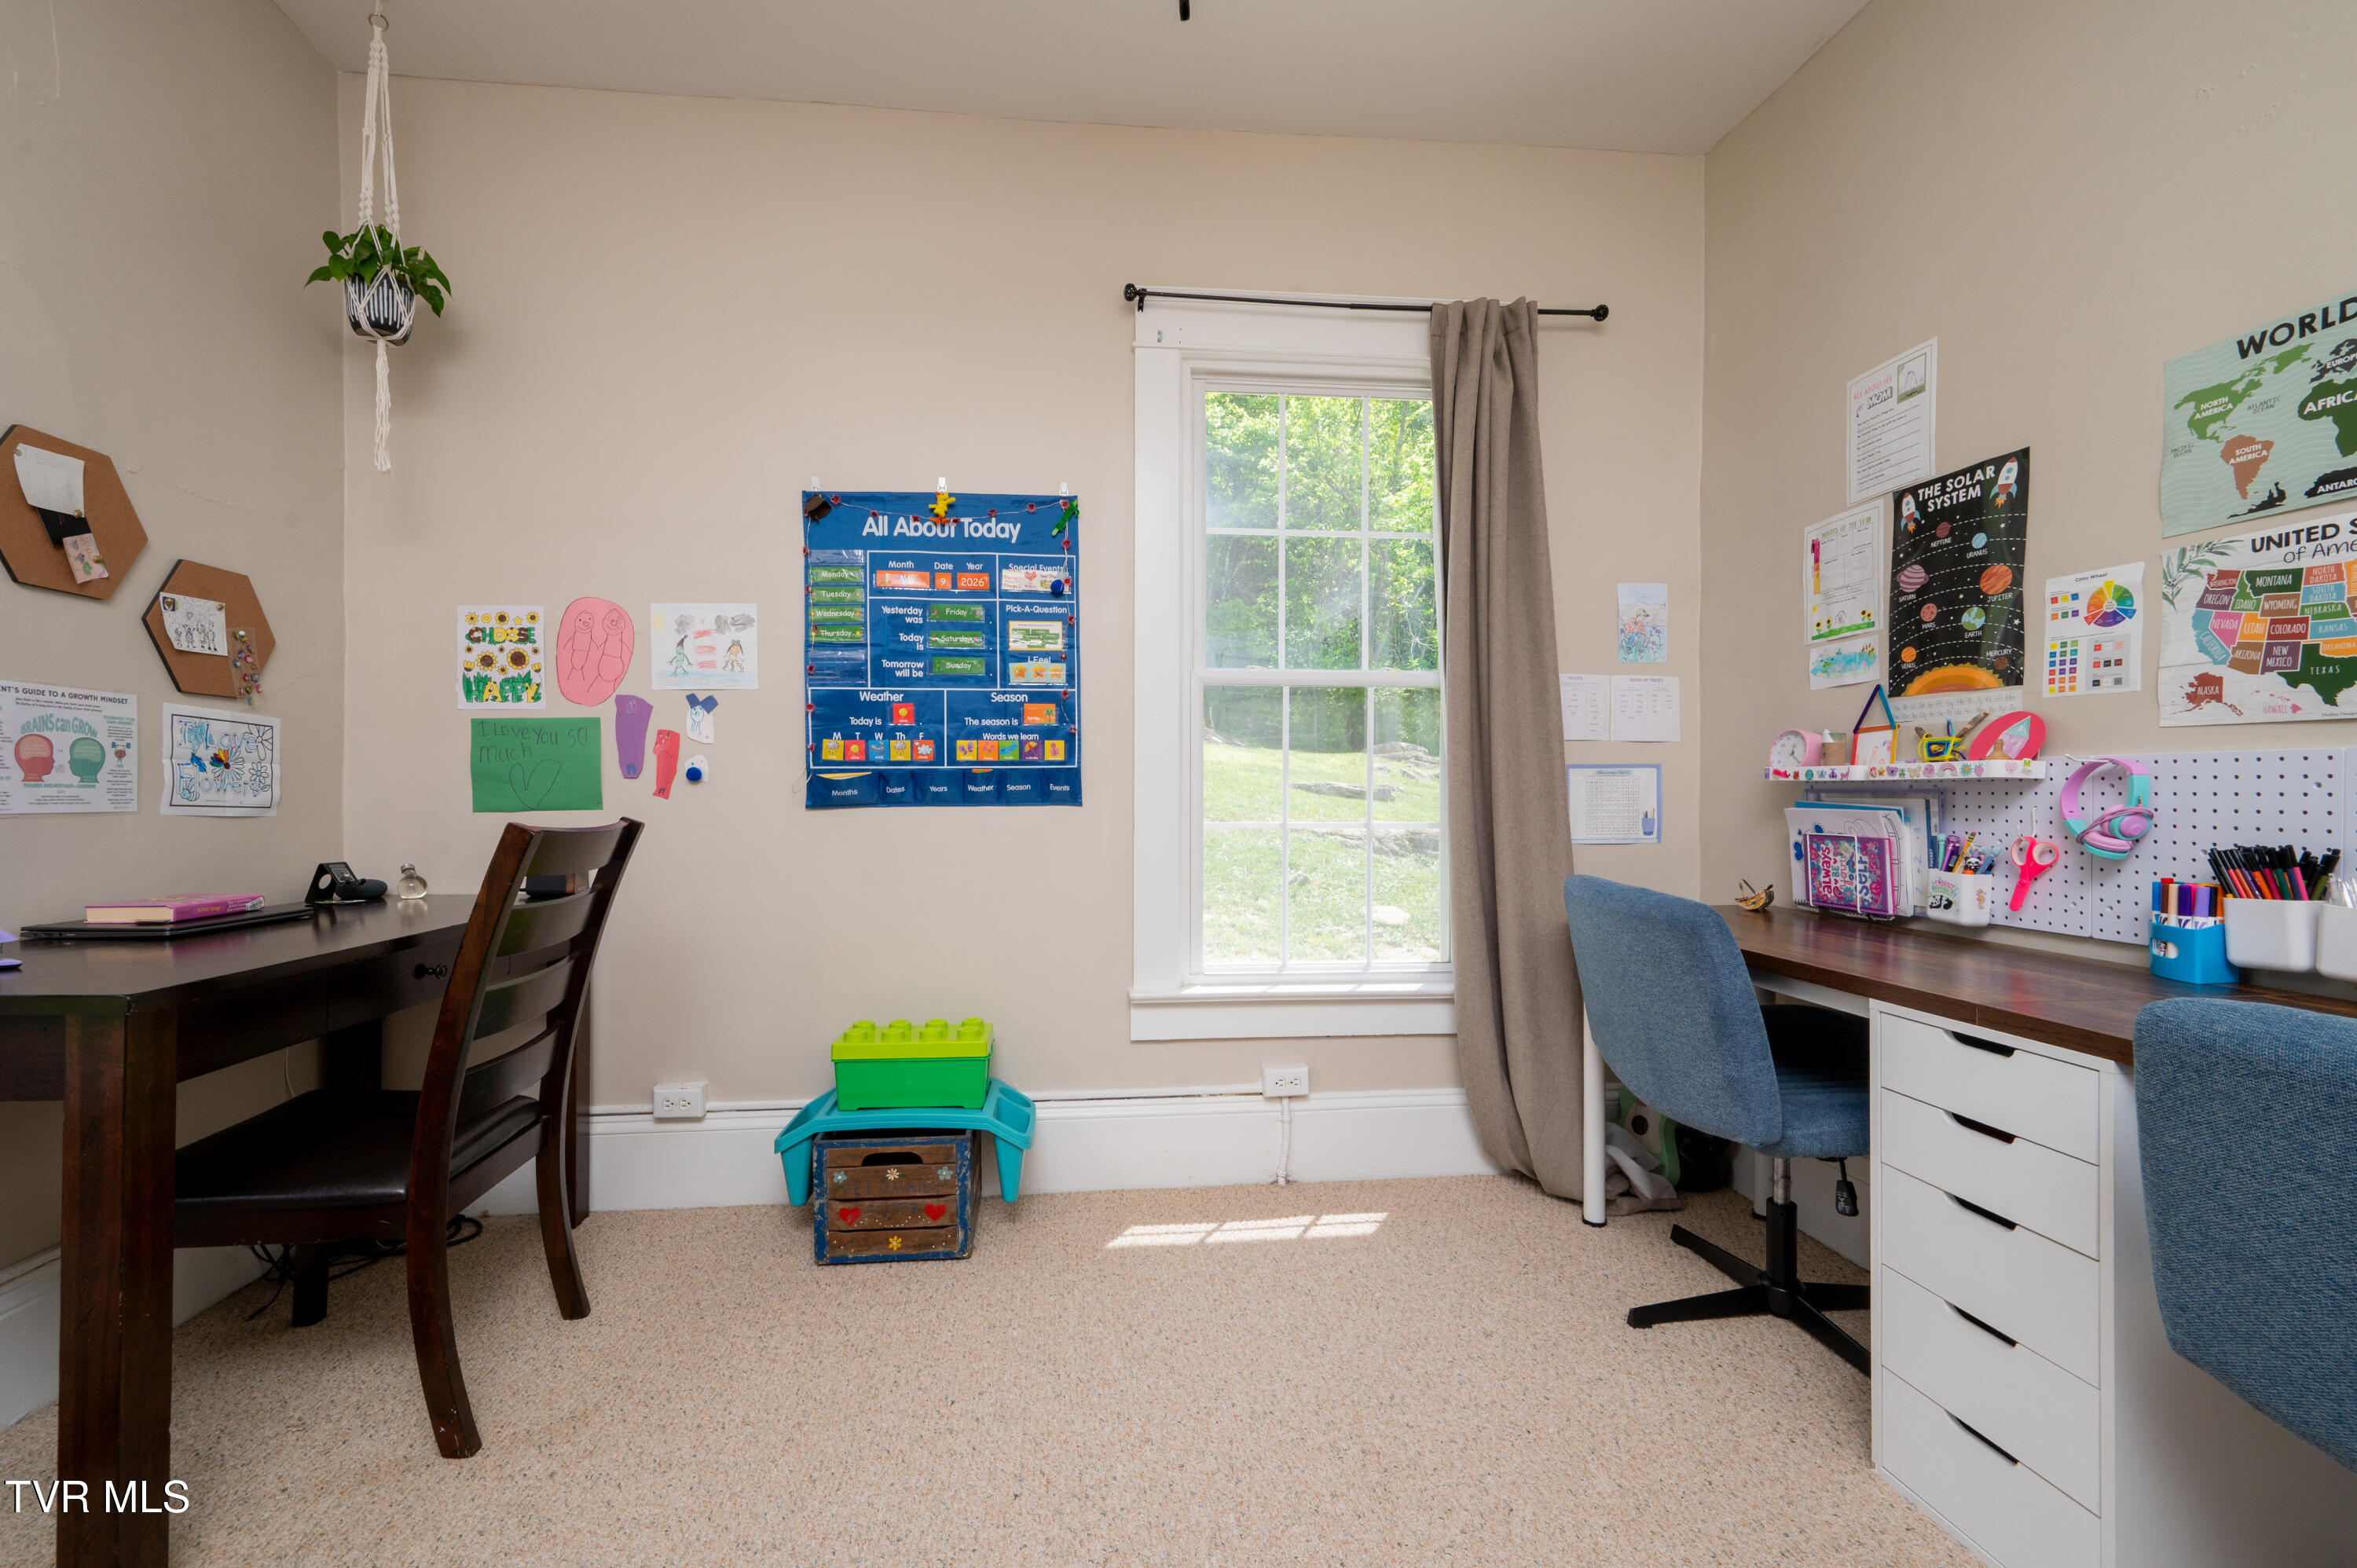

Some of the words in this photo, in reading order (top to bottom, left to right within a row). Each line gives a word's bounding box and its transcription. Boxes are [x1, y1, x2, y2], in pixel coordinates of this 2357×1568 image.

[2236, 296, 2357, 360] WORLD
[2326, 353, 2357, 369] EUROP
[1854, 392, 1863, 401] ALL
[1864, 381, 1882, 394] ABOUT
[1884, 376, 1893, 385] MY
[1867, 386, 1893, 409] MOM
[2201, 396, 2229, 410] NORTH
[2247, 395, 2282, 411] ATLANTIC
[2194, 403, 2234, 420] AMERICA
[2253, 404, 2275, 415] OCEAN
[2170, 442, 2195, 455] PACIFIC
[2235, 444, 2262, 456] SOUTH
[2229, 449, 2268, 465] AMERICA
[1918, 482, 1941, 502] THE
[1946, 465, 1996, 492] SOLAR
[1927, 484, 1981, 512] SYSTEM
[862, 515, 888, 537] All
[893, 515, 957, 538] About
[960, 517, 1021, 544] Today
[1930, 537, 1952, 548] NEPTUNE
[2251, 523, 2341, 553] UNITED
[1966, 548, 1988, 559] URANUS
[2283, 546, 2308, 563] of
[889, 560, 915, 569] Month
[934, 562, 954, 570] Date
[2312, 565, 2335, 575] NORTH
[821, 570, 849, 579] Monday
[2309, 573, 2337, 584] DAKOTA
[961, 577, 984, 587] 2026
[2210, 577, 2237, 588] WASHINGTON
[2256, 574, 2292, 587] MONTANA
[2311, 584, 2335, 594] SOUTH
[1898, 593, 1916, 603] SATURN
[1987, 592, 2013, 603] JUPITER
[2203, 592, 2230, 606] OREGON
[2308, 592, 2337, 603] DAKOTA
[1006, 605, 1067, 614] Pick-A-Question
[2234, 598, 2256, 610] IDAHO
[2264, 599, 2297, 610] WYOMING
[2304, 603, 2342, 616] NEBRASKA
[882, 606, 923, 616] Yesterday
[945, 608, 967, 617] Friday
[2212, 618, 2238, 629] NEVADA
[2243, 622, 2264, 636] UTAH
[2270, 622, 2307, 635] COLORADO
[2319, 621, 2348, 633] KANSAS
[468, 627, 535, 643] CHOOSE
[899, 632, 924, 643] Today
[941, 635, 971, 644] Saturday
[2199, 630, 2227, 661] CALIFORNIA
[2272, 646, 2289, 656] NEW
[1986, 648, 2013, 658] MERCURY
[2234, 650, 2261, 661] ARIZONA
[882, 659, 924, 669] Tomorrow
[946, 661, 972, 670] Sunday
[2266, 656, 2293, 667] MEXICO
[2310, 665, 2341, 675] TEXAS
[466, 680, 538, 703] HAPPY
[2197, 684, 2220, 695] ALASKA
[22, 687, 46, 697] GUIDE
[68, 692, 98, 702] GROWTH
[101, 696, 129, 705] MINDSET
[860, 691, 904, 702] Weather
[991, 692, 1028, 702] Season
[2263, 703, 2288, 715] HAWAII
[20, 713, 56, 735] BRAINS
[55, 716, 71, 732] can
[71, 716, 98, 738] GROW
[849, 716, 874, 727] Today
[874, 716, 882, 726] is
[964, 716, 980, 726] The
[1012, 716, 1018, 726] is
[478, 721, 489, 737] I
[493, 722, 530, 740] Love
[832, 731, 841, 740] M
[855, 731, 861, 740] T
[895, 731, 906, 740] Th
[204, 722, 259, 753] Love
[1020, 732, 1039, 741] learn
[479, 742, 533, 764] much
[175, 760, 262, 797] Flowers
[1831, 865, 1839, 877] BE
